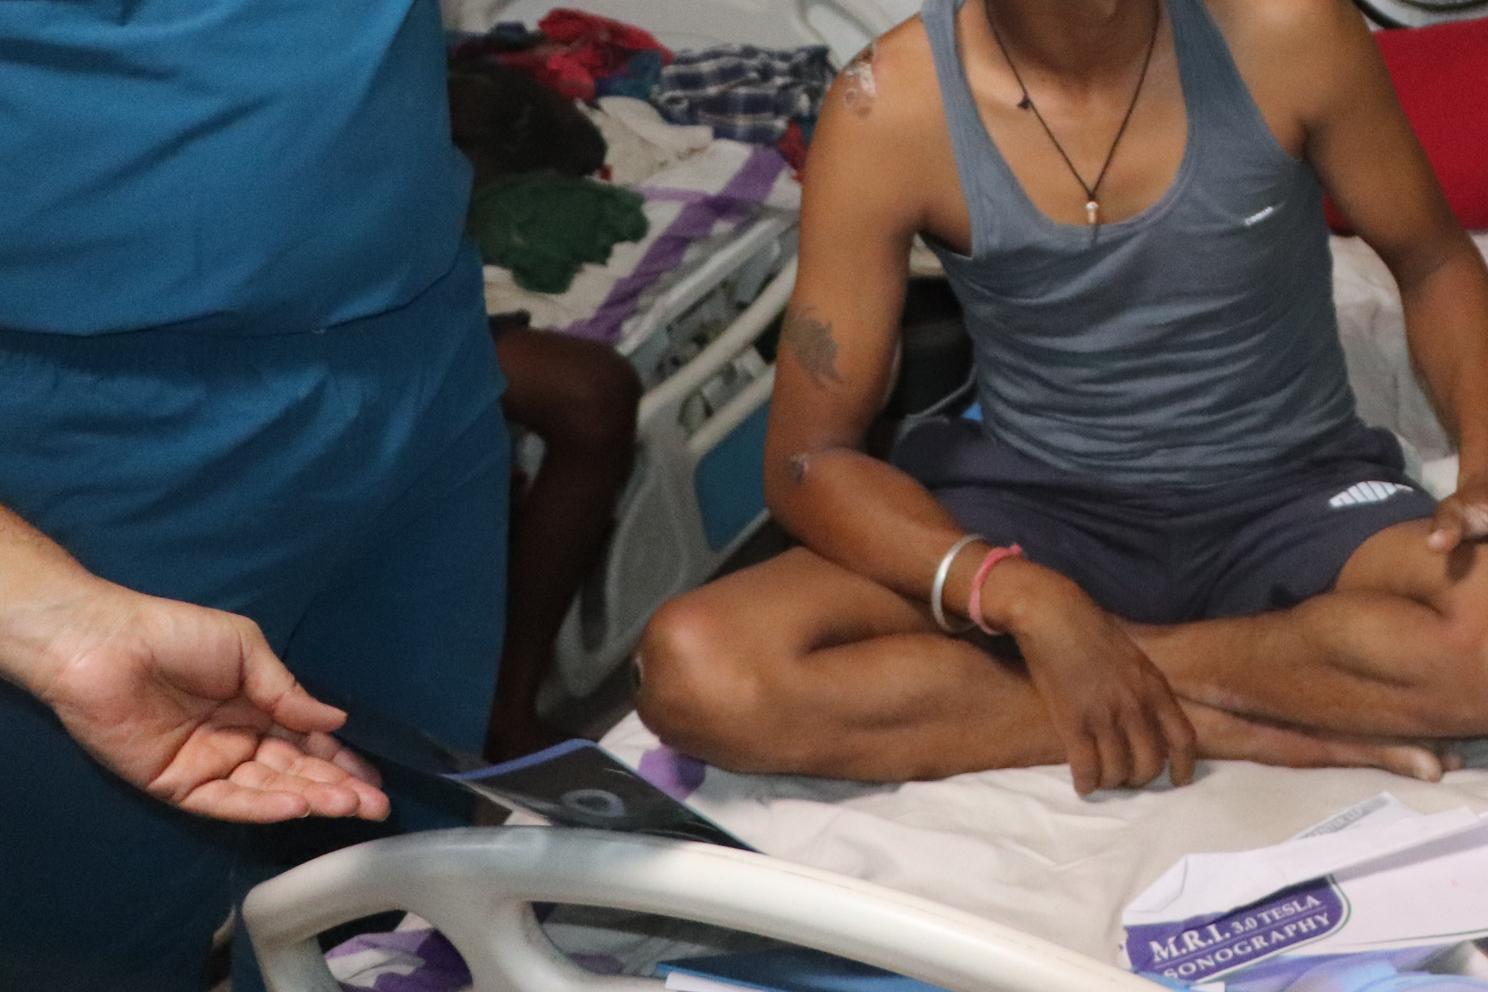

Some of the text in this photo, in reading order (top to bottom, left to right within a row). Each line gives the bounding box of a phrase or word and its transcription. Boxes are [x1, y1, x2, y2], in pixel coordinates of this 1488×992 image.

[1150, 894, 1322, 962] M.R.I. 3.0 TESLA
[1163, 912, 1331, 978] SONOGRAPHY
